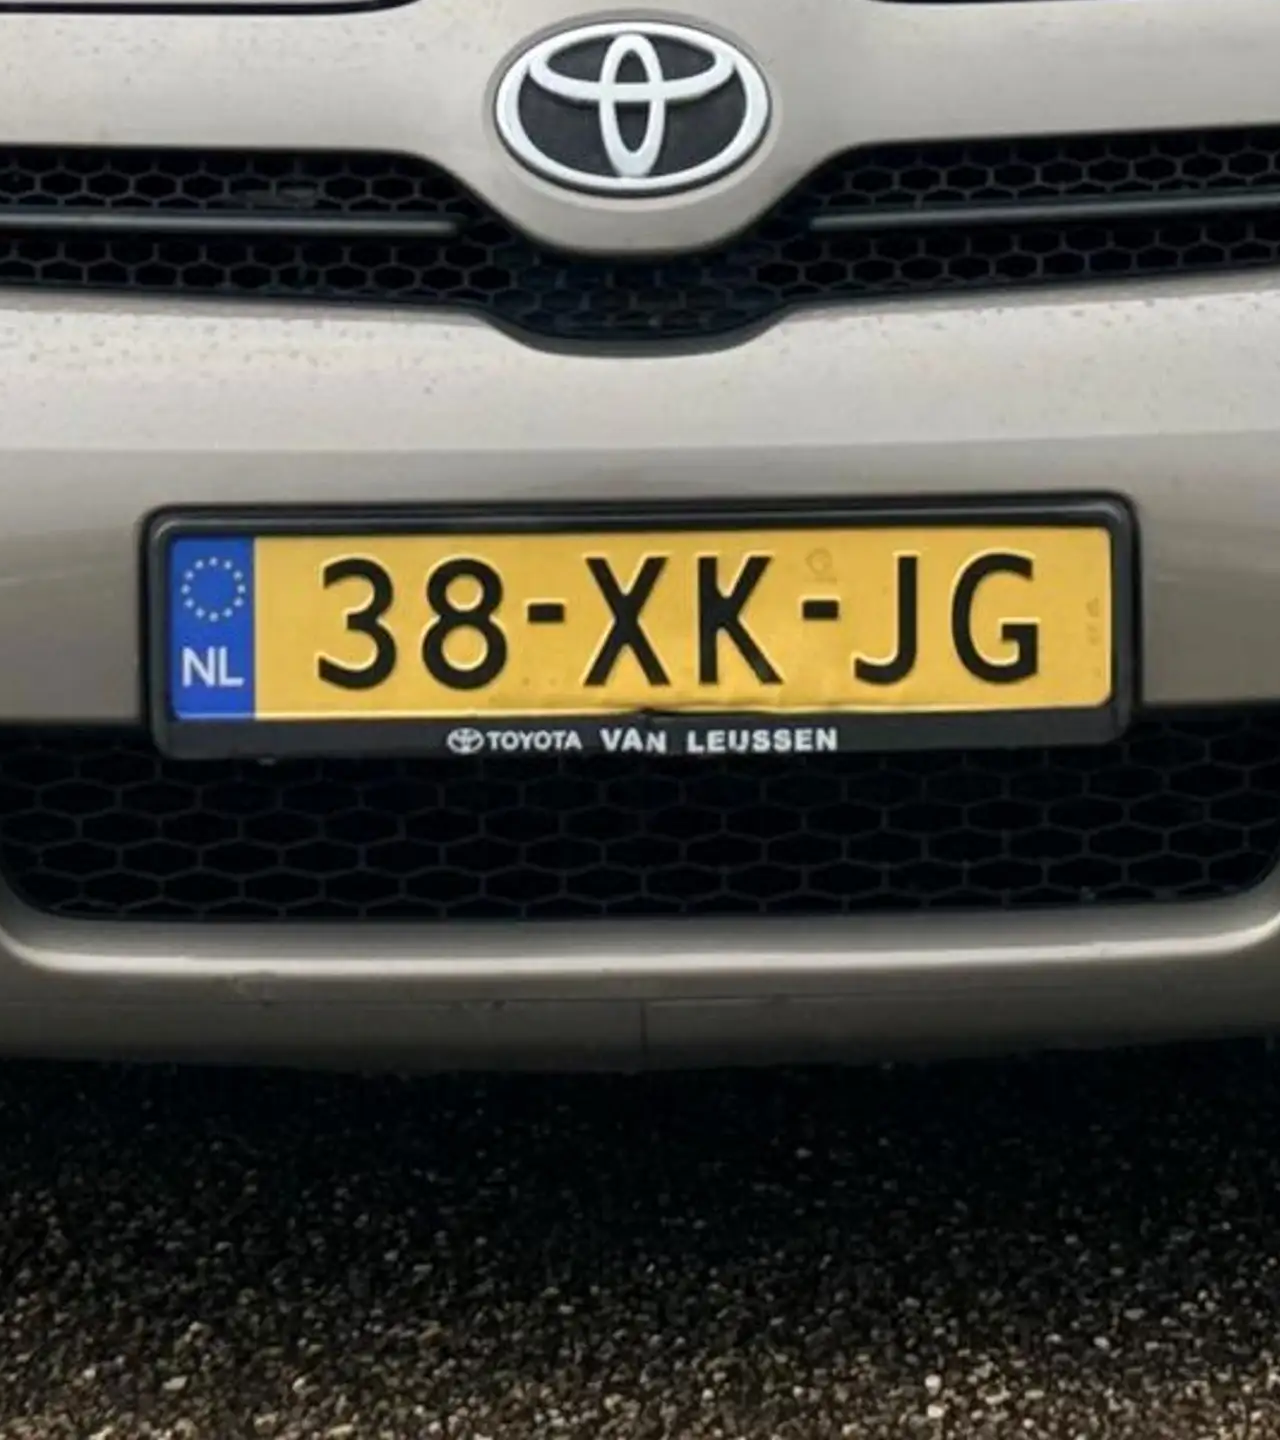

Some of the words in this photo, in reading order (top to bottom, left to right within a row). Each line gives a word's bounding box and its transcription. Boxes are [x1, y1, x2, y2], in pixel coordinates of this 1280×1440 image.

[317, 553, 1040, 691] 38-XK-JG
[182, 646, 244, 687] NL
[486, 729, 583, 751] TOYOTA
[599, 727, 667, 754] VAN
[686, 727, 839, 754] LEUSSEN
